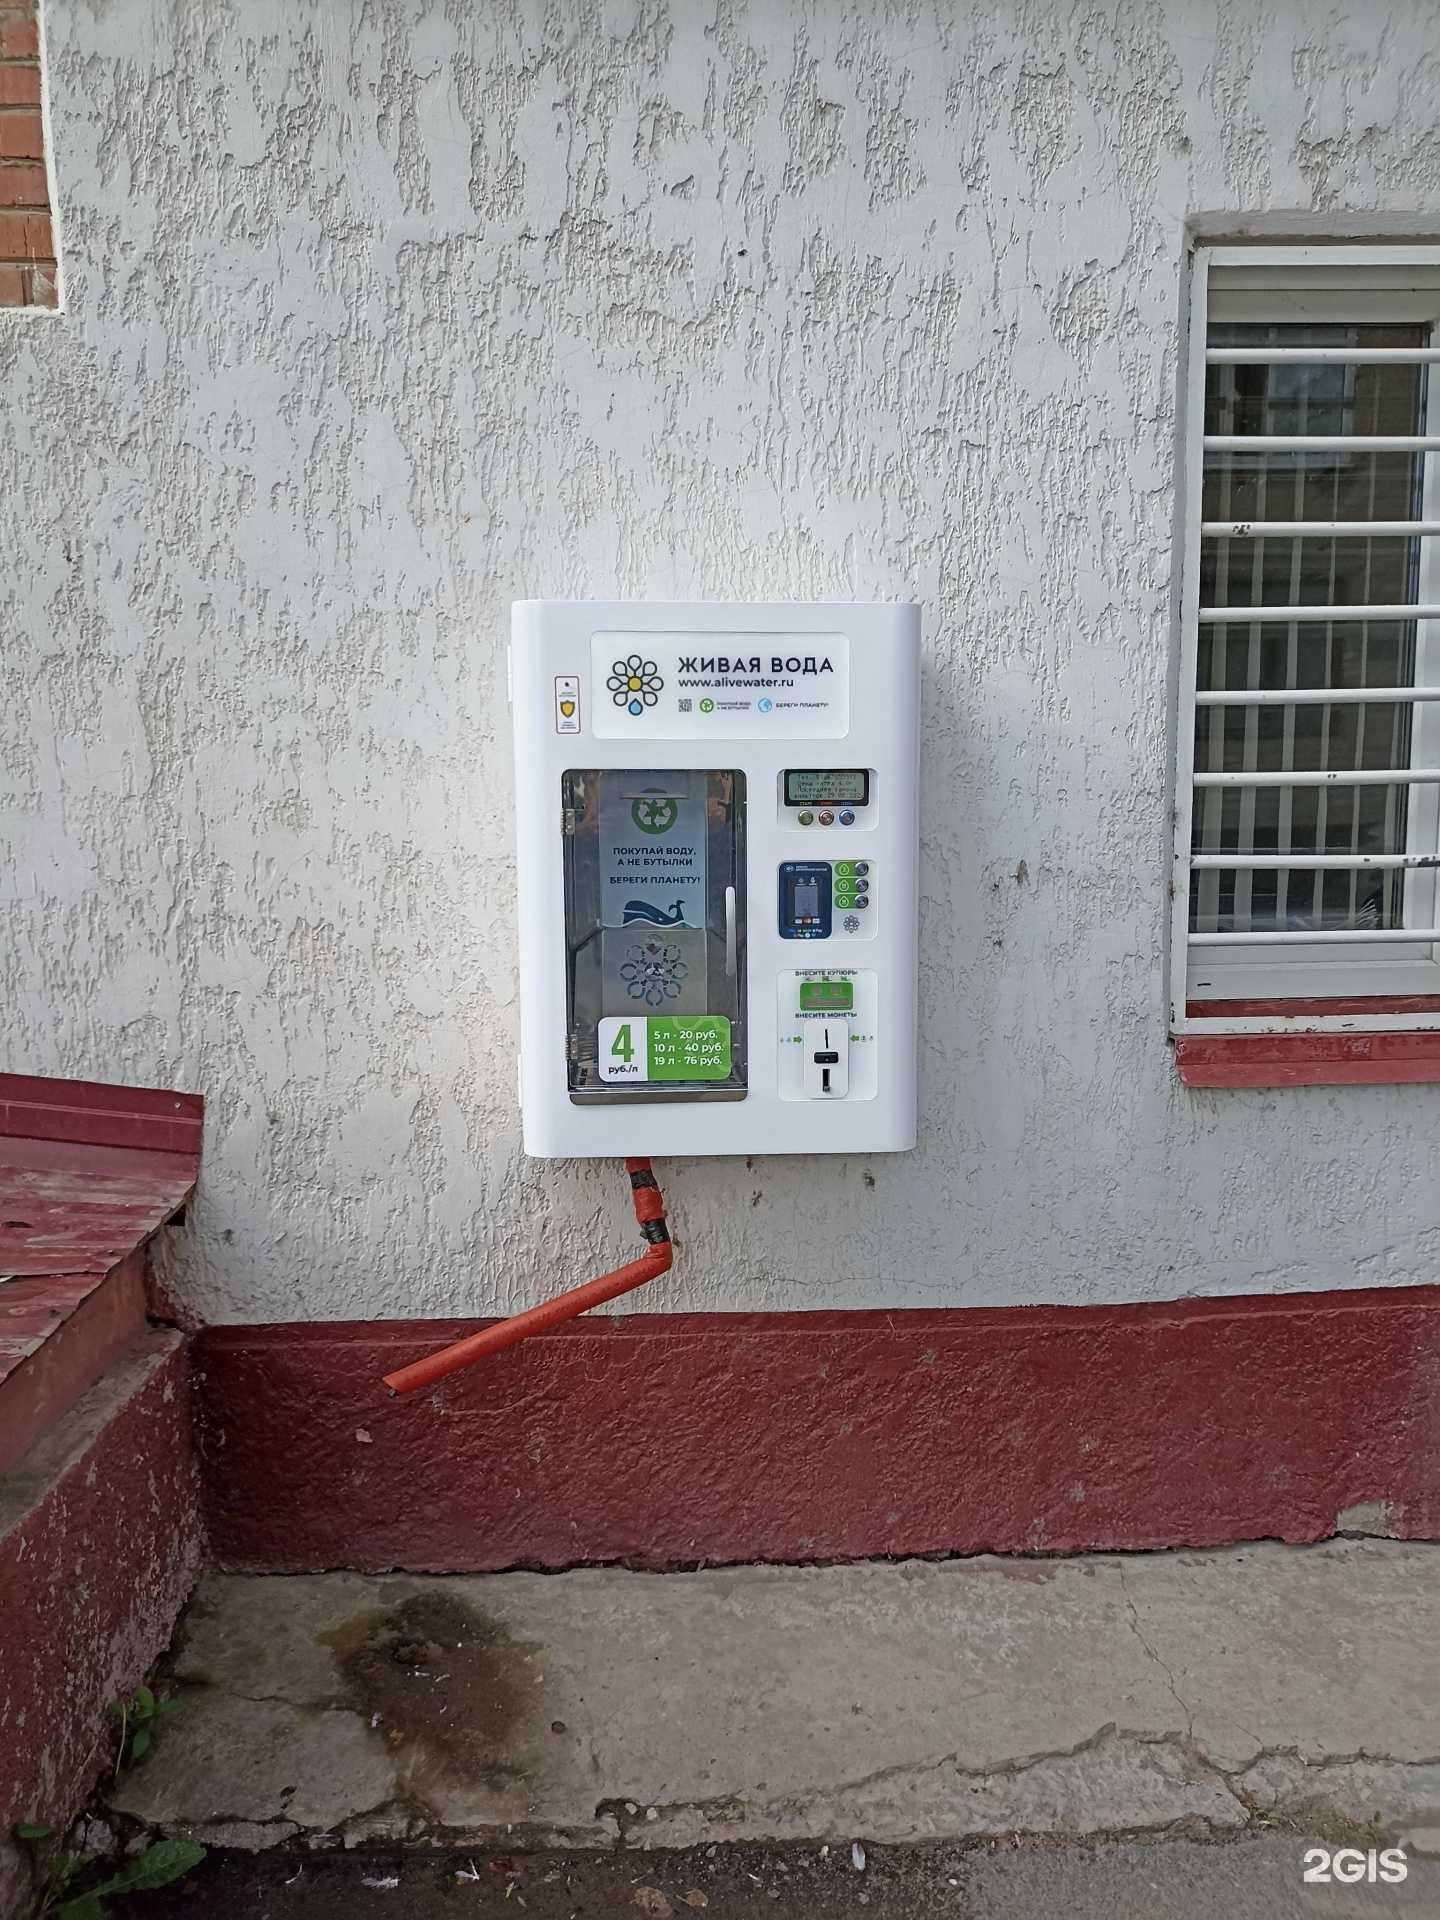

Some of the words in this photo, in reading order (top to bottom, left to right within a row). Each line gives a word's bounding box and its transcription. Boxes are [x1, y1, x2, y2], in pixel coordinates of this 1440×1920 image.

[678, 657, 761, 673] ЖИВАЯ
[771, 657, 834, 675] ВОДА
[678, 677, 794, 687] www.alivewater.ru
[613, 846, 663, 855] ПОКУПАЙ
[666, 847, 697, 856] ВОДУ,
[617, 858, 624, 866] А
[627, 858, 640, 866] НЕ
[643, 858, 693, 866] БУТЫЛКИ
[610, 876, 647, 884] БЕРЕГИ
[651, 876, 700, 884] ПЛАНЕТУ!
[654, 1031, 661, 1039] 5
[680, 1030, 693, 1039] 20
[696, 1030, 718, 1040] руб.
[611, 1024, 635, 1063] 4
[654, 1043, 665, 1052] 10
[684, 1043, 699, 1052] 40
[702, 1042, 724, 1053] руб.
[654, 1056, 665, 1065] 19
[684, 1056, 698, 1065] 76
[700, 1056, 722, 1066] руб.
[608, 1064, 638, 1074] руб./л
